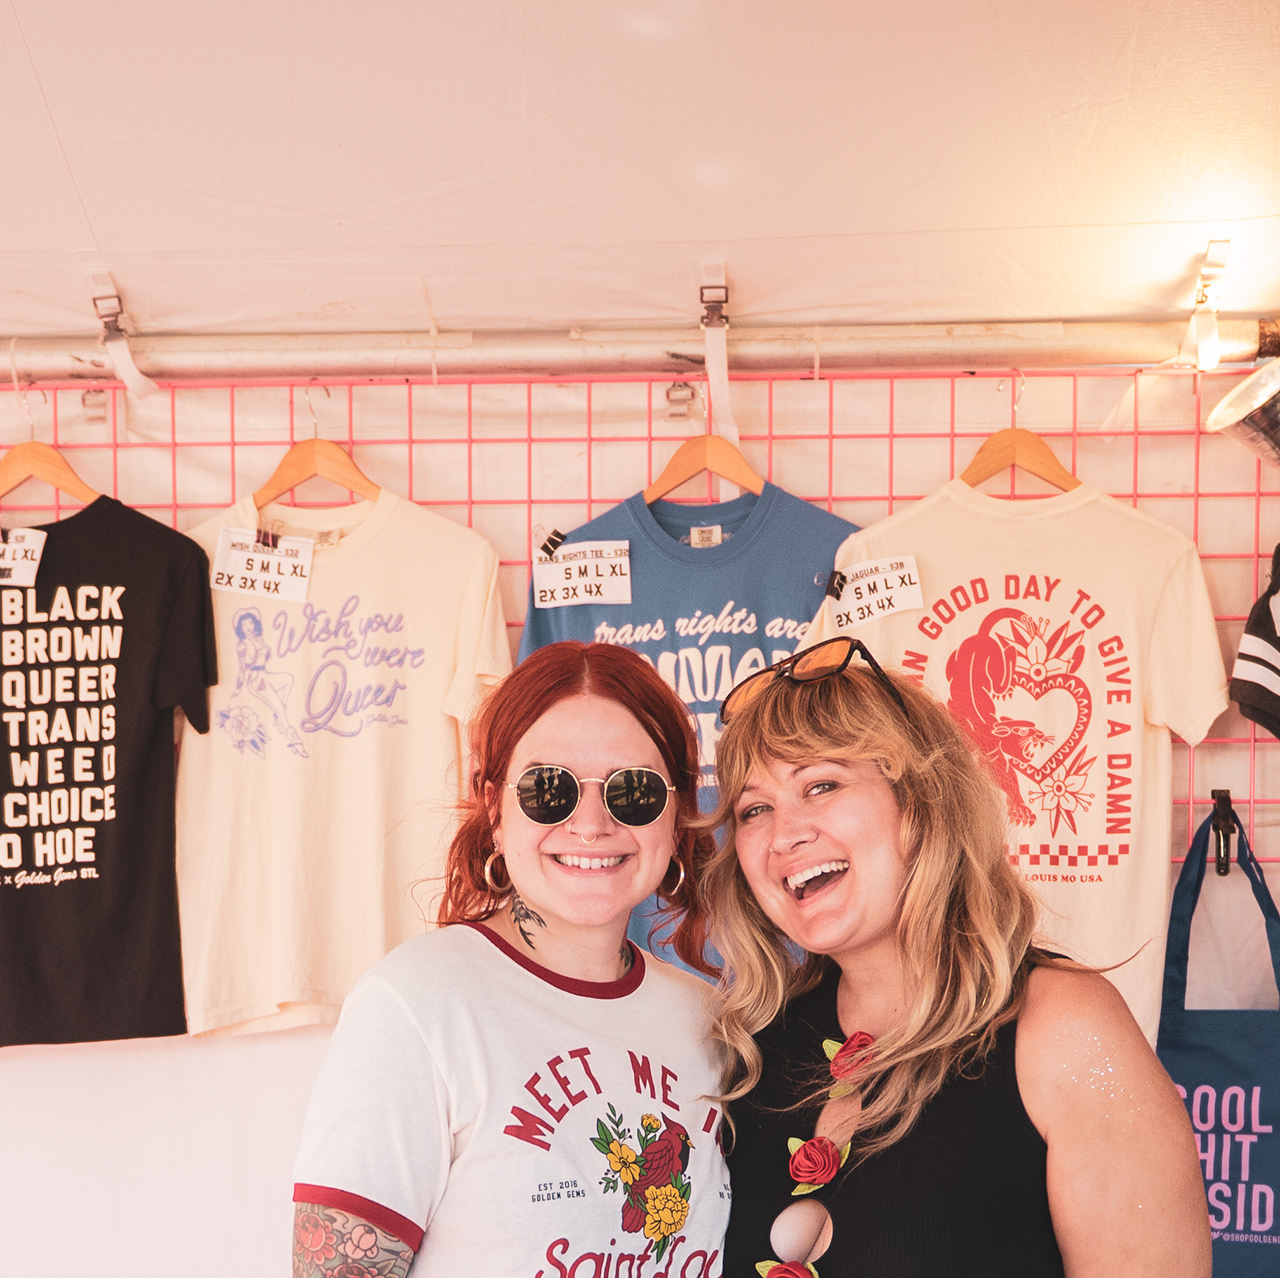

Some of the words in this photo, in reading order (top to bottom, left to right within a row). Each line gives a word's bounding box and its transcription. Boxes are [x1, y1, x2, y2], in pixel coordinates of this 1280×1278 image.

[21, 548, 37, 561] XL
[290, 563, 308, 578] XL
[609, 563, 627, 577] XL
[851, 565, 880, 583] JAGUAR
[215, 572, 234, 587] 2X
[238, 576, 257, 591] 3X
[263, 579, 281, 594] 4X
[539, 588, 556, 602] 2X
[562, 586, 578, 600] 3X
[584, 583, 603, 597] 4X
[898, 573, 917, 588] XL
[1004, 574, 1061, 600] DAY
[1, 585, 126, 625] BLACK
[595, 619, 666, 645] trans
[676, 600, 758, 646] rights
[765, 617, 811, 640] are
[836, 611, 854, 628] 2X
[858, 603, 875, 620] 3X
[877, 597, 895, 612] 4X
[918, 577, 990, 641] GOOD
[1068, 589, 1105, 629] TO
[1, 625, 124, 666] BROWN
[272, 594, 361, 659] Wish
[342, 612, 404, 660] you
[364, 646, 425, 669] were
[1098, 635, 1132, 705] GIVE
[1, 664, 117, 709] QUEER
[300, 660, 407, 738] Queer
[2, 706, 116, 748] TRANS
[1107, 720, 1132, 738] A
[9, 745, 116, 787] WEED
[3, 785, 116, 828] CHOICE
[1106, 753, 1132, 834] DAMN
[33, 827, 96, 867] HOE
[14, 870, 52, 889] Golden
[80, 867, 99, 879] STL
[1024, 874, 1058, 883] LOUIS
[1061, 874, 1076, 883] MO
[1080, 874, 1103, 883] USA
[503, 1046, 603, 1152] MEET
[627, 1050, 680, 1112] ME
[1195, 1133, 1258, 1182] HIT
[531, 1191, 563, 1203] GOLDEN
[566, 1190, 586, 1200] GEMS
[538, 1183, 554, 1192] EST
[559, 1180, 578, 1190] 2016
